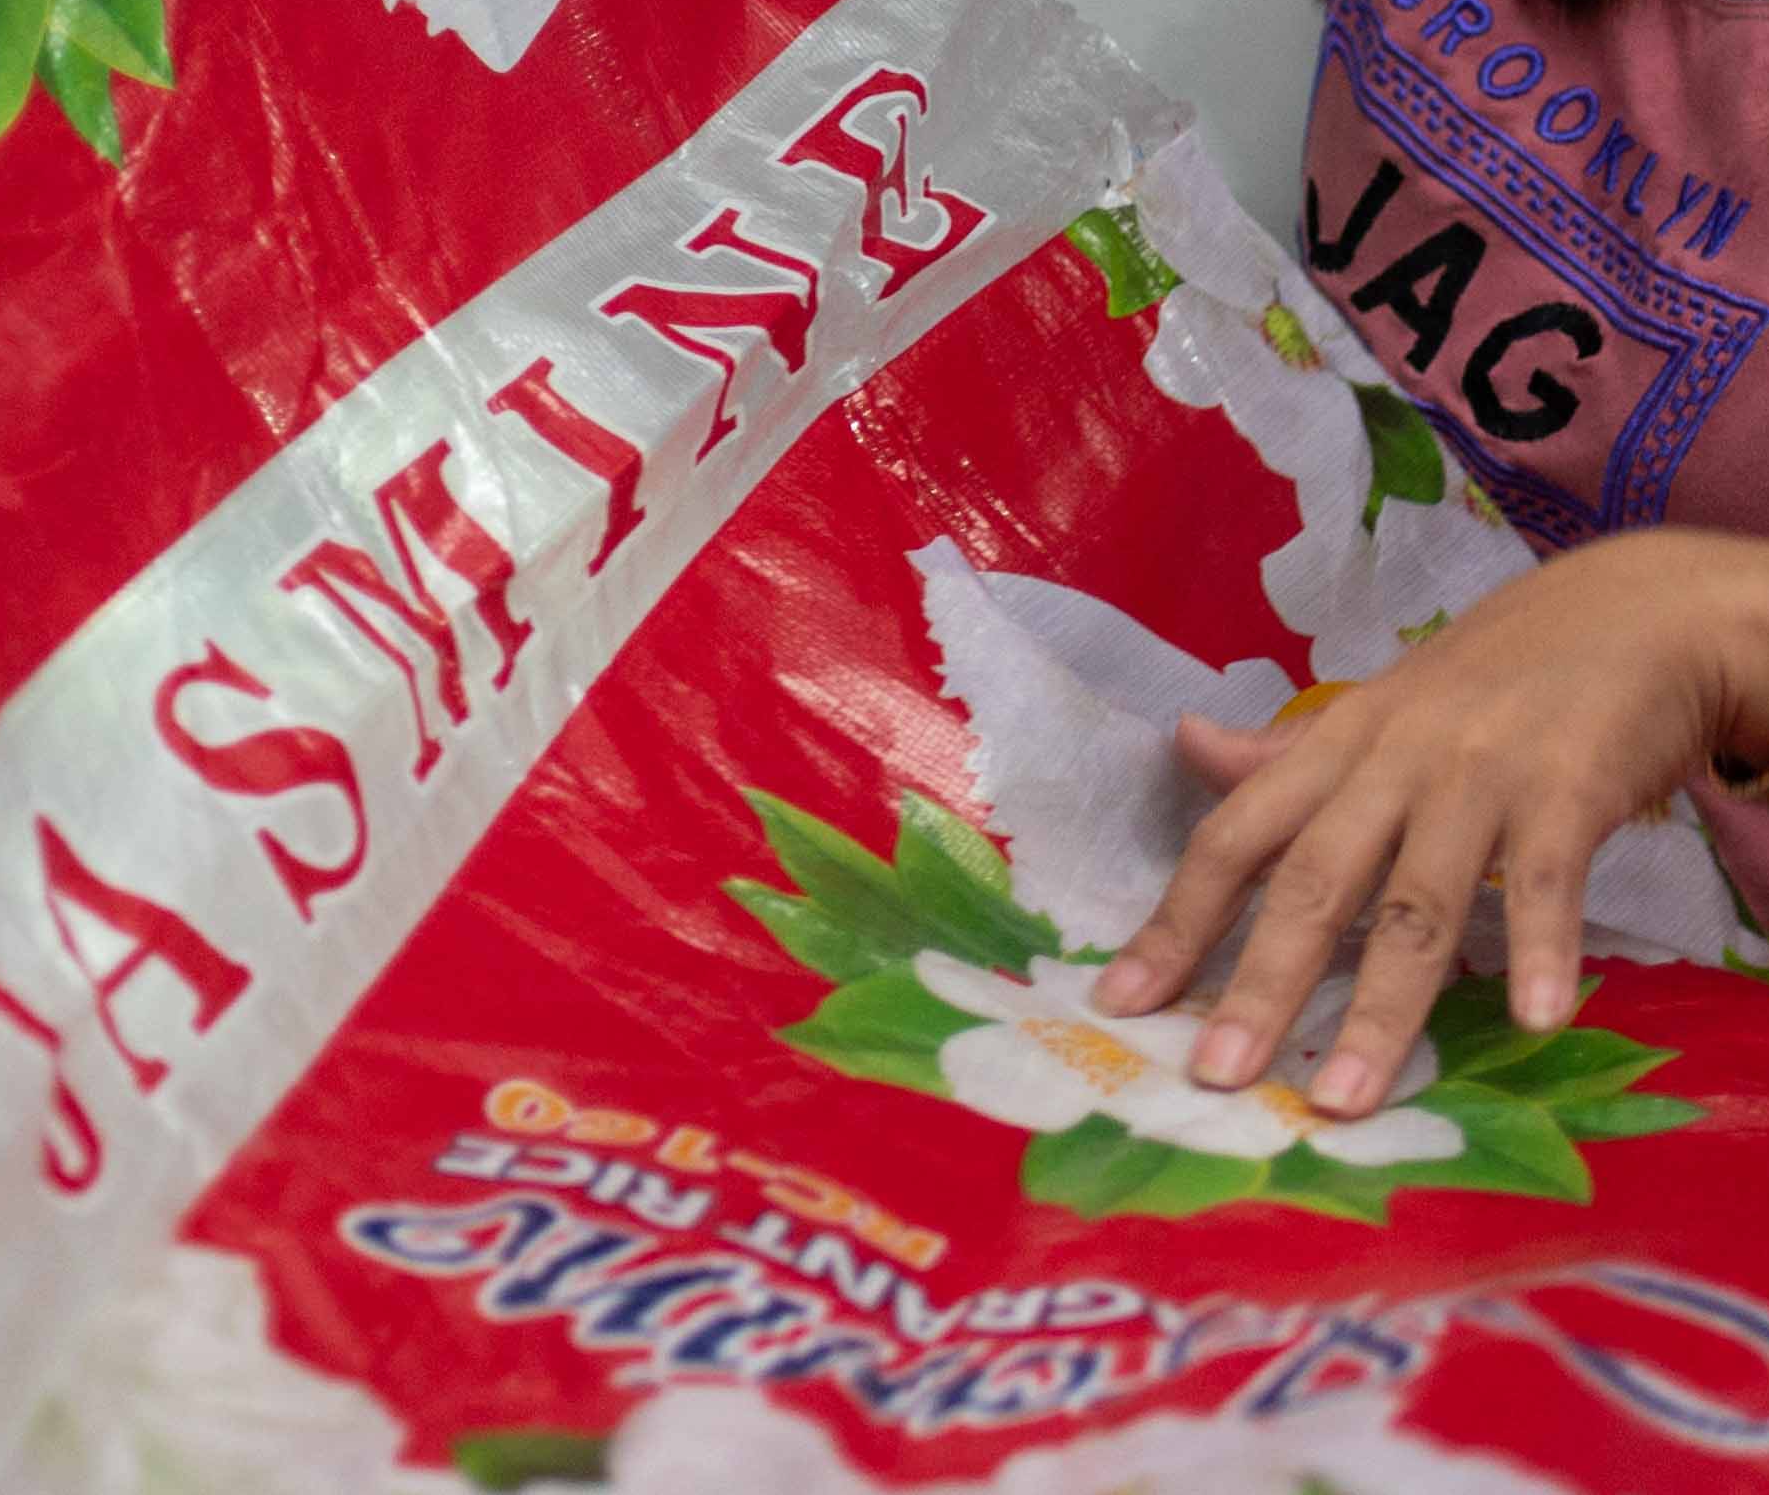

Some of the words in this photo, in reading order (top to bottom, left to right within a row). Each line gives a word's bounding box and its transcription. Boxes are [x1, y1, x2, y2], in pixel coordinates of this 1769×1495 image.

[1303, 157, 1605, 443] JAG
[433, 1133, 715, 1230] RICE
[721, 1211, 1371, 1343] GRANT
